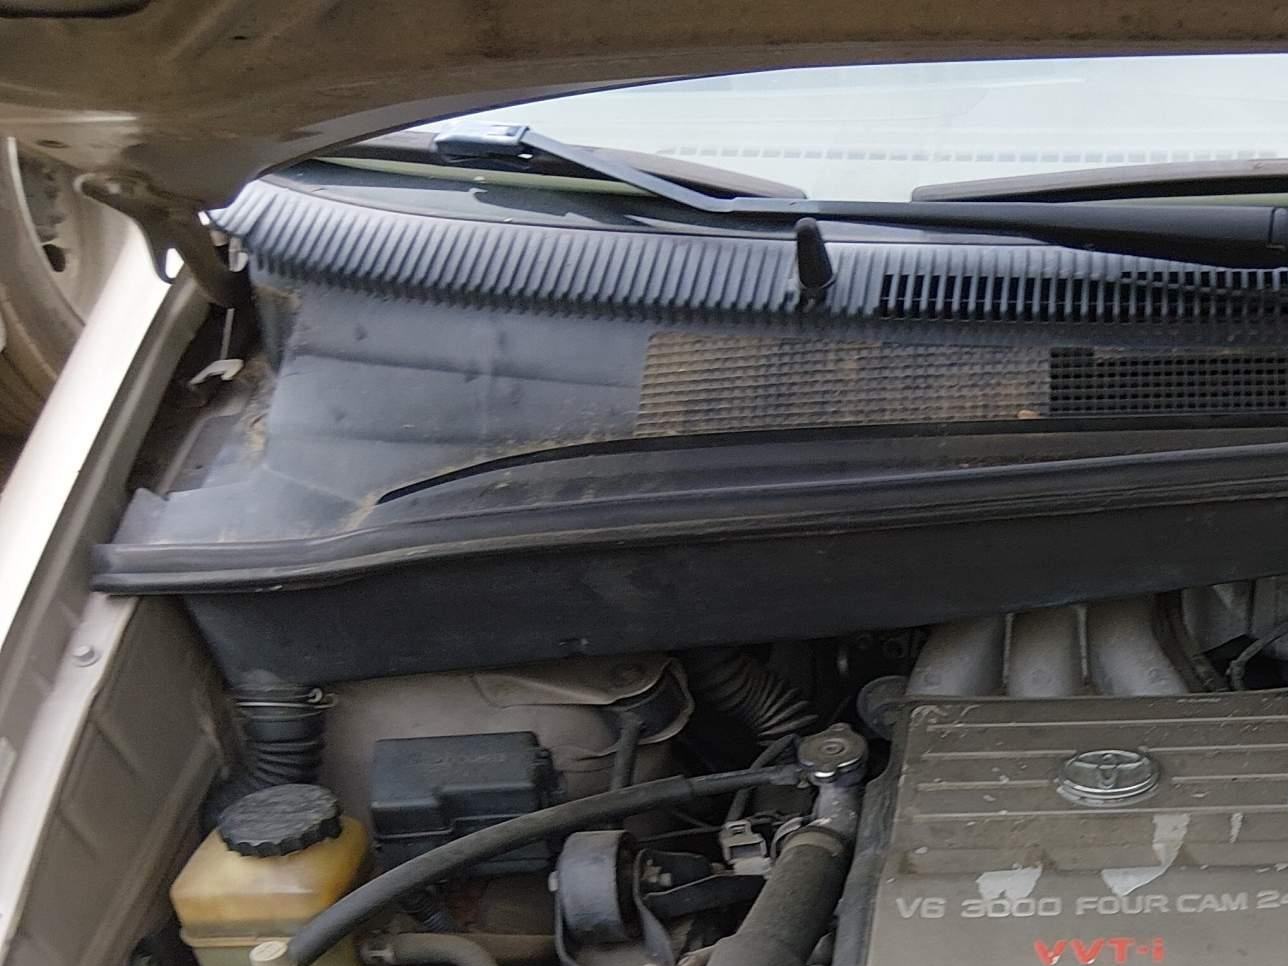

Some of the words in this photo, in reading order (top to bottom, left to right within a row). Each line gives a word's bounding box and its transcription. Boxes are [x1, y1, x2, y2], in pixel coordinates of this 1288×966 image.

[896, 897, 947, 919] V6
[960, 896, 1062, 918] 3000
[1075, 894, 1171, 916] FOUR
[1176, 892, 1249, 914] CAM
[1034, 937, 1165, 966] VVT-i
